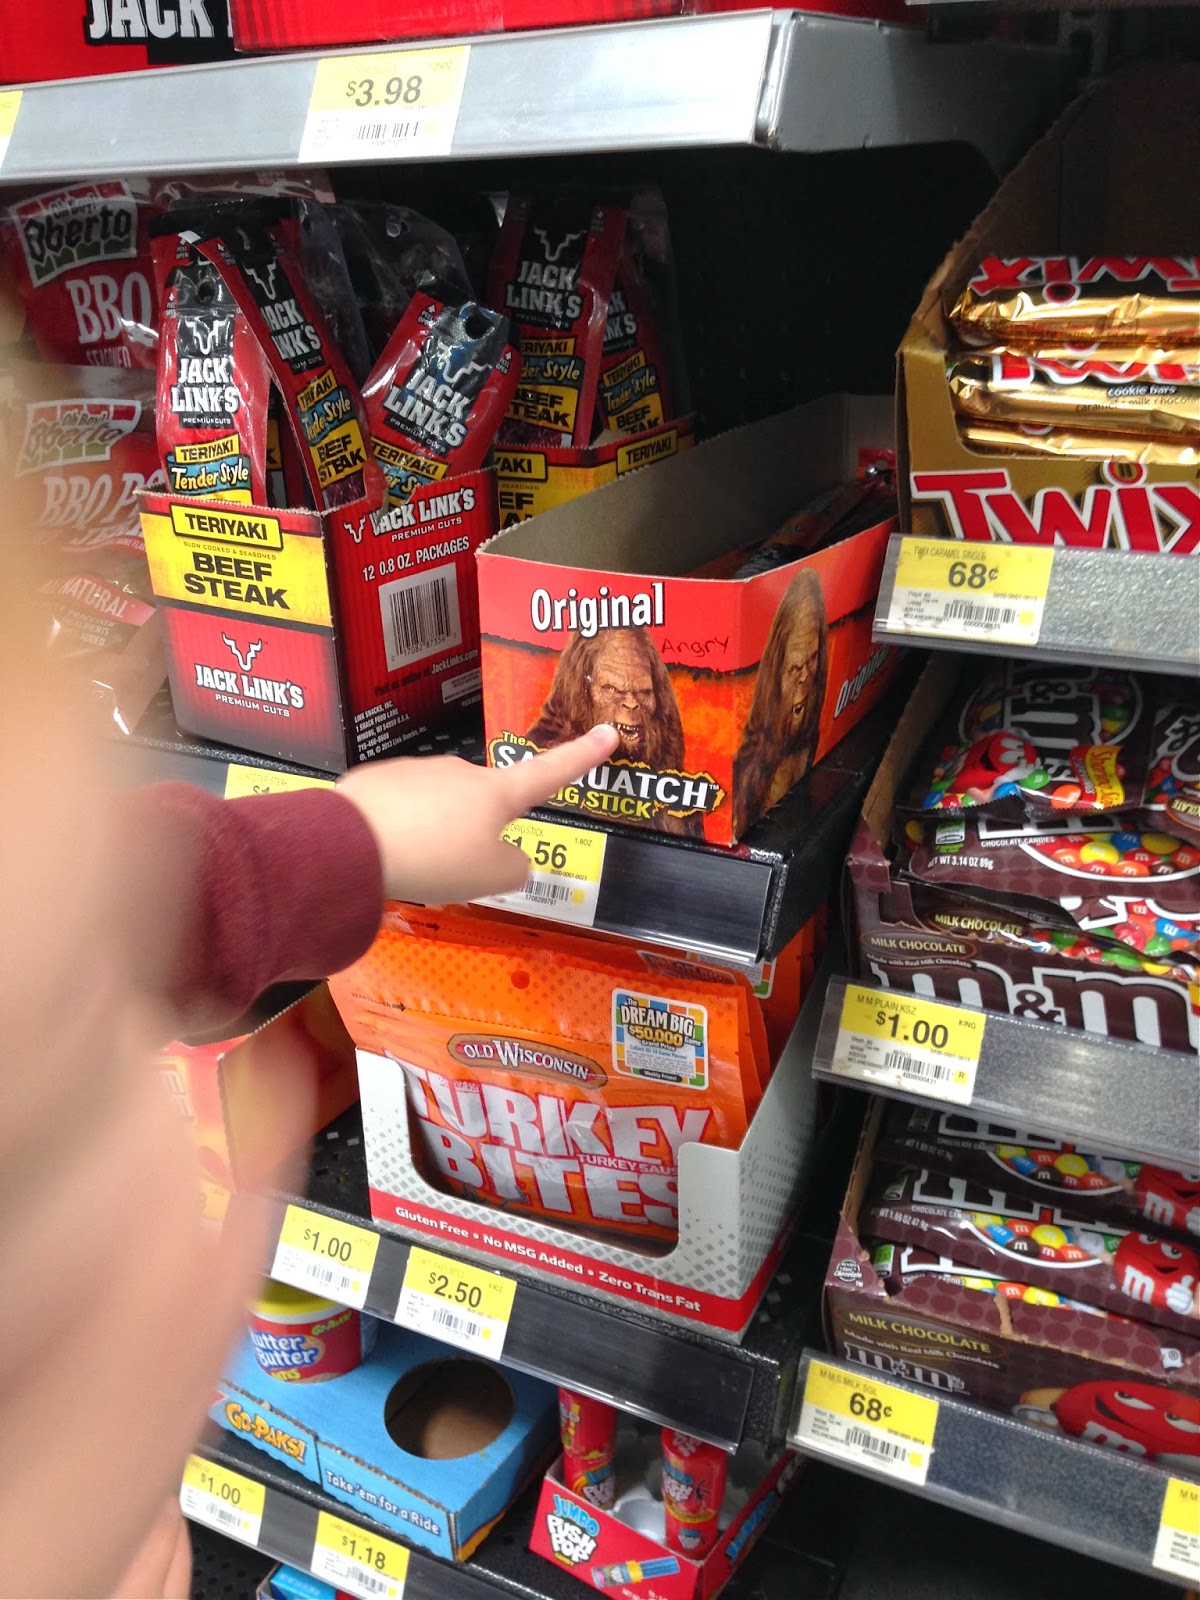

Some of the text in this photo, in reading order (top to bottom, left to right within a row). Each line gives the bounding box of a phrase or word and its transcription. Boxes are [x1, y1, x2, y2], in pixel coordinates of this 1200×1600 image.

[89, 0, 214, 38] JACK
[346, 75, 422, 107] $3.98
[23, 205, 132, 264] Oberto
[517, 260, 576, 291] JACK
[506, 284, 583, 319] LINK'S
[178, 357, 226, 384] JACK
[543, 360, 580, 381] Style
[606, 355, 641, 386] TERIYAKI
[631, 369, 656, 394] Style
[171, 385, 240, 413] LINK'S
[406, 367, 470, 419] JACK
[1107, 384, 1178, 398] cookie bars
[324, 390, 351, 424] Style
[383, 385, 467, 447] LINK'S
[616, 406, 651, 428] BEEF
[180, 440, 234, 461] TERIYAKI
[316, 434, 353, 464] BEEF
[371, 441, 440, 476] TERIYAKI
[626, 437, 672, 465] TERIYAKI
[170, 467, 219, 491] Tender
[219, 458, 249, 484] Style
[319, 447, 367, 483] STEAK
[501, 483, 540, 491] SEASONED
[418, 487, 476, 523] LINK'S
[185, 513, 268, 541] TERIYAKI
[391, 516, 463, 542] PREMIUM CUTS
[183, 541, 201, 549] SLOW
[203, 544, 231, 554] COOKED
[239, 550, 277, 561] SEASONED
[362, 536, 470, 582] 12 0.8 OZ. PACKAGES
[930, 547, 961, 559] CARAMEL
[962, 550, 986, 560] SINGLE
[192, 551, 272, 582] BEEF
[947, 561, 999, 589] 68¢
[59, 577, 129, 620] NATURAL
[183, 572, 291, 610] STEAK
[530, 582, 666, 638] Original
[431, 648, 479, 675] JackLinks.com
[661, 636, 730, 658] Angry
[195, 664, 305, 709] JACK LINK'S
[215, 693, 291, 718] PREMIUM CUTS
[502, 731, 526, 745] The
[586, 791, 652, 819] STICK
[526, 826, 544, 838] STICK
[980, 836, 1056, 848] CHOCOLATE CANDIES
[939, 855, 994, 871] WT 3.14 OZ 89g
[934, 914, 1023, 937] MILK CHOCOLATE
[870, 936, 966, 955] MILK CHOCOLATE
[882, 956, 903, 966] with
[904, 957, 919, 967] Real
[920, 958, 934, 967] Milk
[935, 958, 972, 969] Chocolate
[626, 996, 638, 1007] The
[874, 998, 901, 1012] PLAIN
[900, 1004, 917, 1016] KSZ
[620, 1004, 694, 1037] DREAM BIG
[628, 1024, 684, 1047] $50,000
[876, 1010, 949, 1049] $1.00
[958, 1019, 976, 1030] KING
[463, 1039, 590, 1080] OLD WISCONSIN
[641, 1040, 676, 1052] Grand Prize
[385, 1050, 711, 1166] TURKEY
[419, 1119, 679, 1228] BITES
[577, 1153, 638, 1172] TURKEY
[911, 1205, 949, 1218] CHOCOLATE
[303, 1228, 352, 1262] $1.00
[394, 1205, 702, 1312] Gluten Free No MSG Added Zero Trans Fat
[428, 1271, 482, 1308] $2.50
[848, 1312, 992, 1354] MILK CHOCOLATE
[257, 1347, 318, 1369] Butter
[844, 1329, 1000, 1370] Made with Real Milk Chocolate
[849, 1392, 893, 1422] 68¢
[200, 1472, 241, 1505] $1.00
[325, 1471, 440, 1535] Take 'em for a Ride
[552, 1494, 600, 1537] JUMBO
[546, 1513, 597, 1556] PUSH
[552, 1532, 590, 1562] POP
[341, 1535, 386, 1571] $1.18
